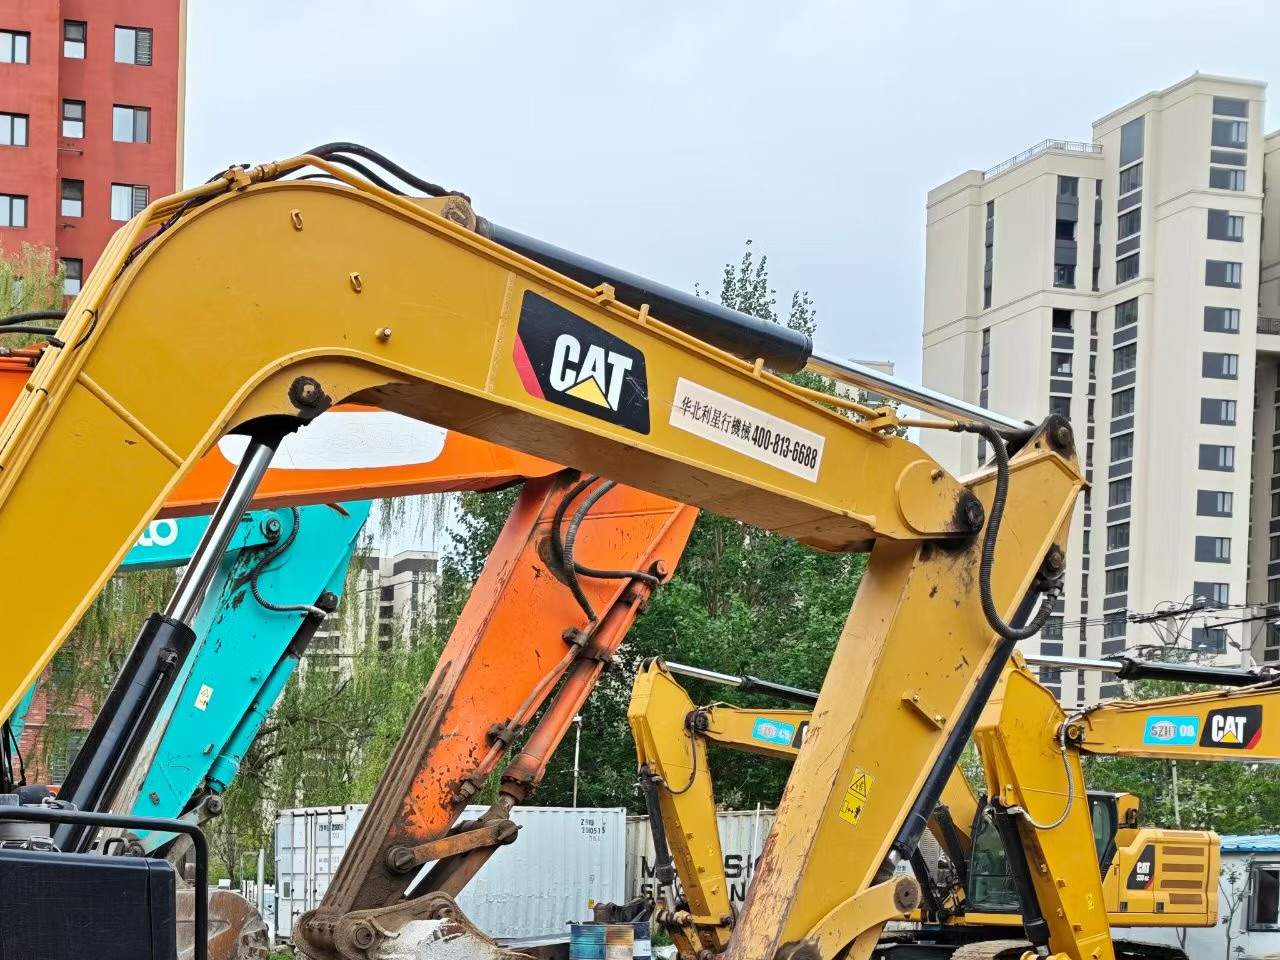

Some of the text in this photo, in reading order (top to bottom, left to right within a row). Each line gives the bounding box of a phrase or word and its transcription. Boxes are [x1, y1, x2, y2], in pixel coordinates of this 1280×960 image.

[549, 334, 633, 411] CAT
[752, 425, 818, 469] 400-813-6688
[1211, 715, 1247, 744] CAT
[1136, 862, 1151, 874] CAT
